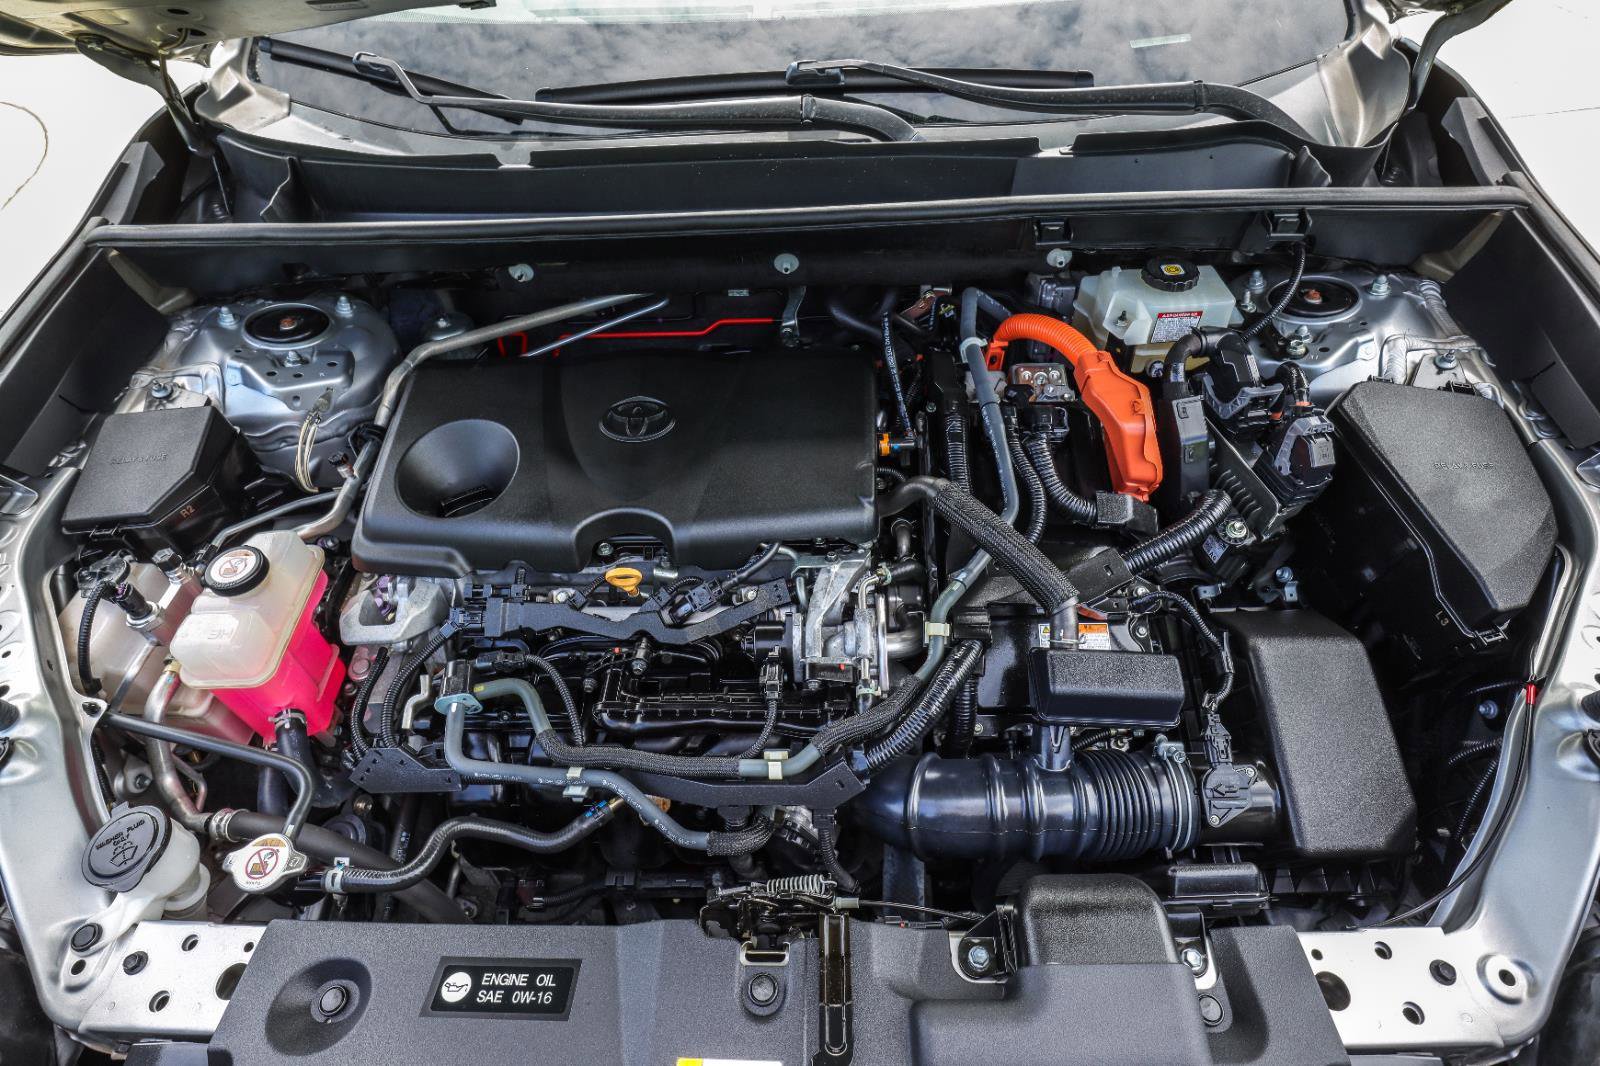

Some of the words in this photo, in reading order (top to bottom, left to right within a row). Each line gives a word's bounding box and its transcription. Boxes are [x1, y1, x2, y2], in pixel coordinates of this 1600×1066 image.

[180, 505, 196, 518] R2
[481, 973, 530, 986] ENGINE
[536, 974, 556, 987] OIL
[476, 990, 504, 1003] SAE
[511, 991, 553, 1004] 0W-16
